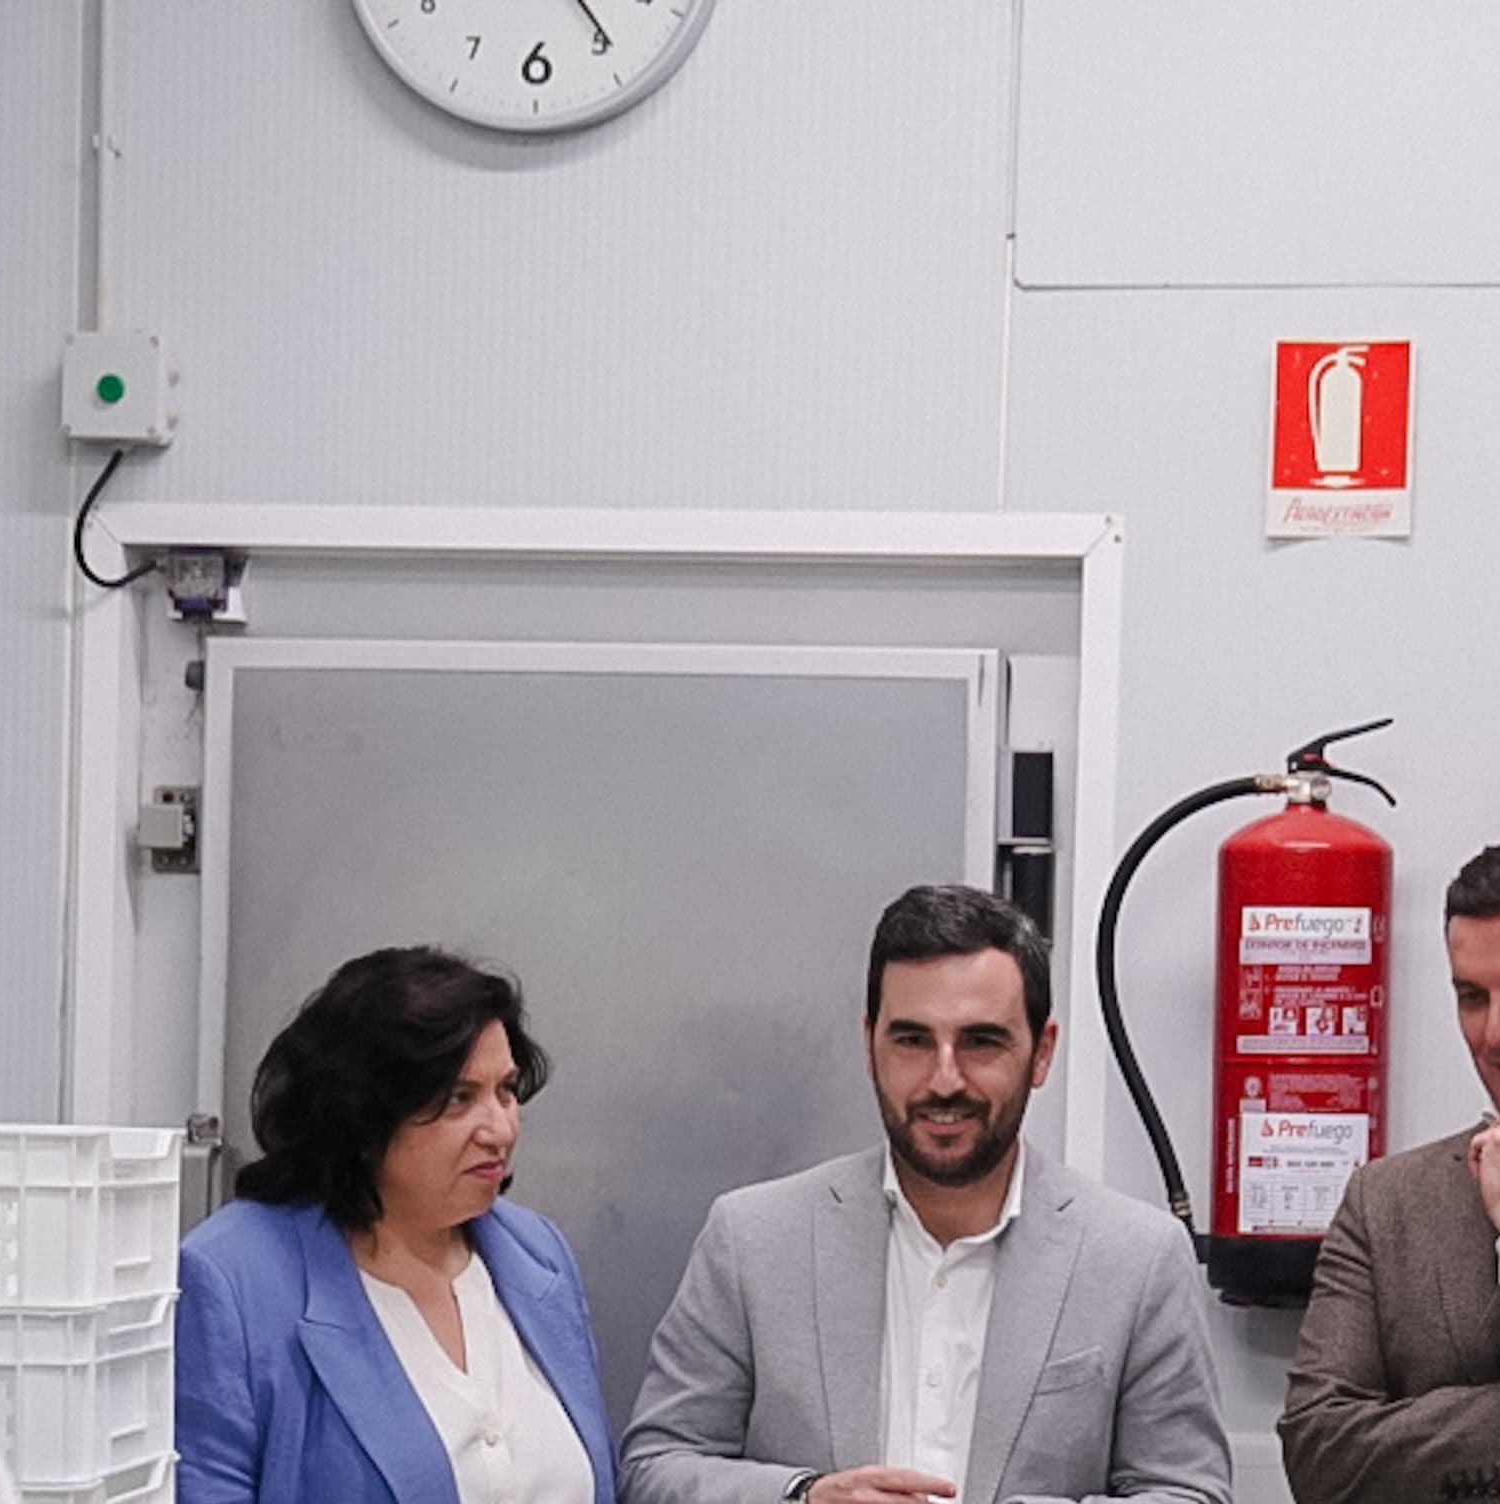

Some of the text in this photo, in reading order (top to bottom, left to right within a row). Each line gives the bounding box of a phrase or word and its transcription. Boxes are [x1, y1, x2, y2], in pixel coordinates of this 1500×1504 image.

[465, 35, 482, 60] 7
[521, 41, 552, 85] 6
[1264, 913, 1344, 937] Prefuego
[1278, 1119, 1353, 1144] Prefuego
